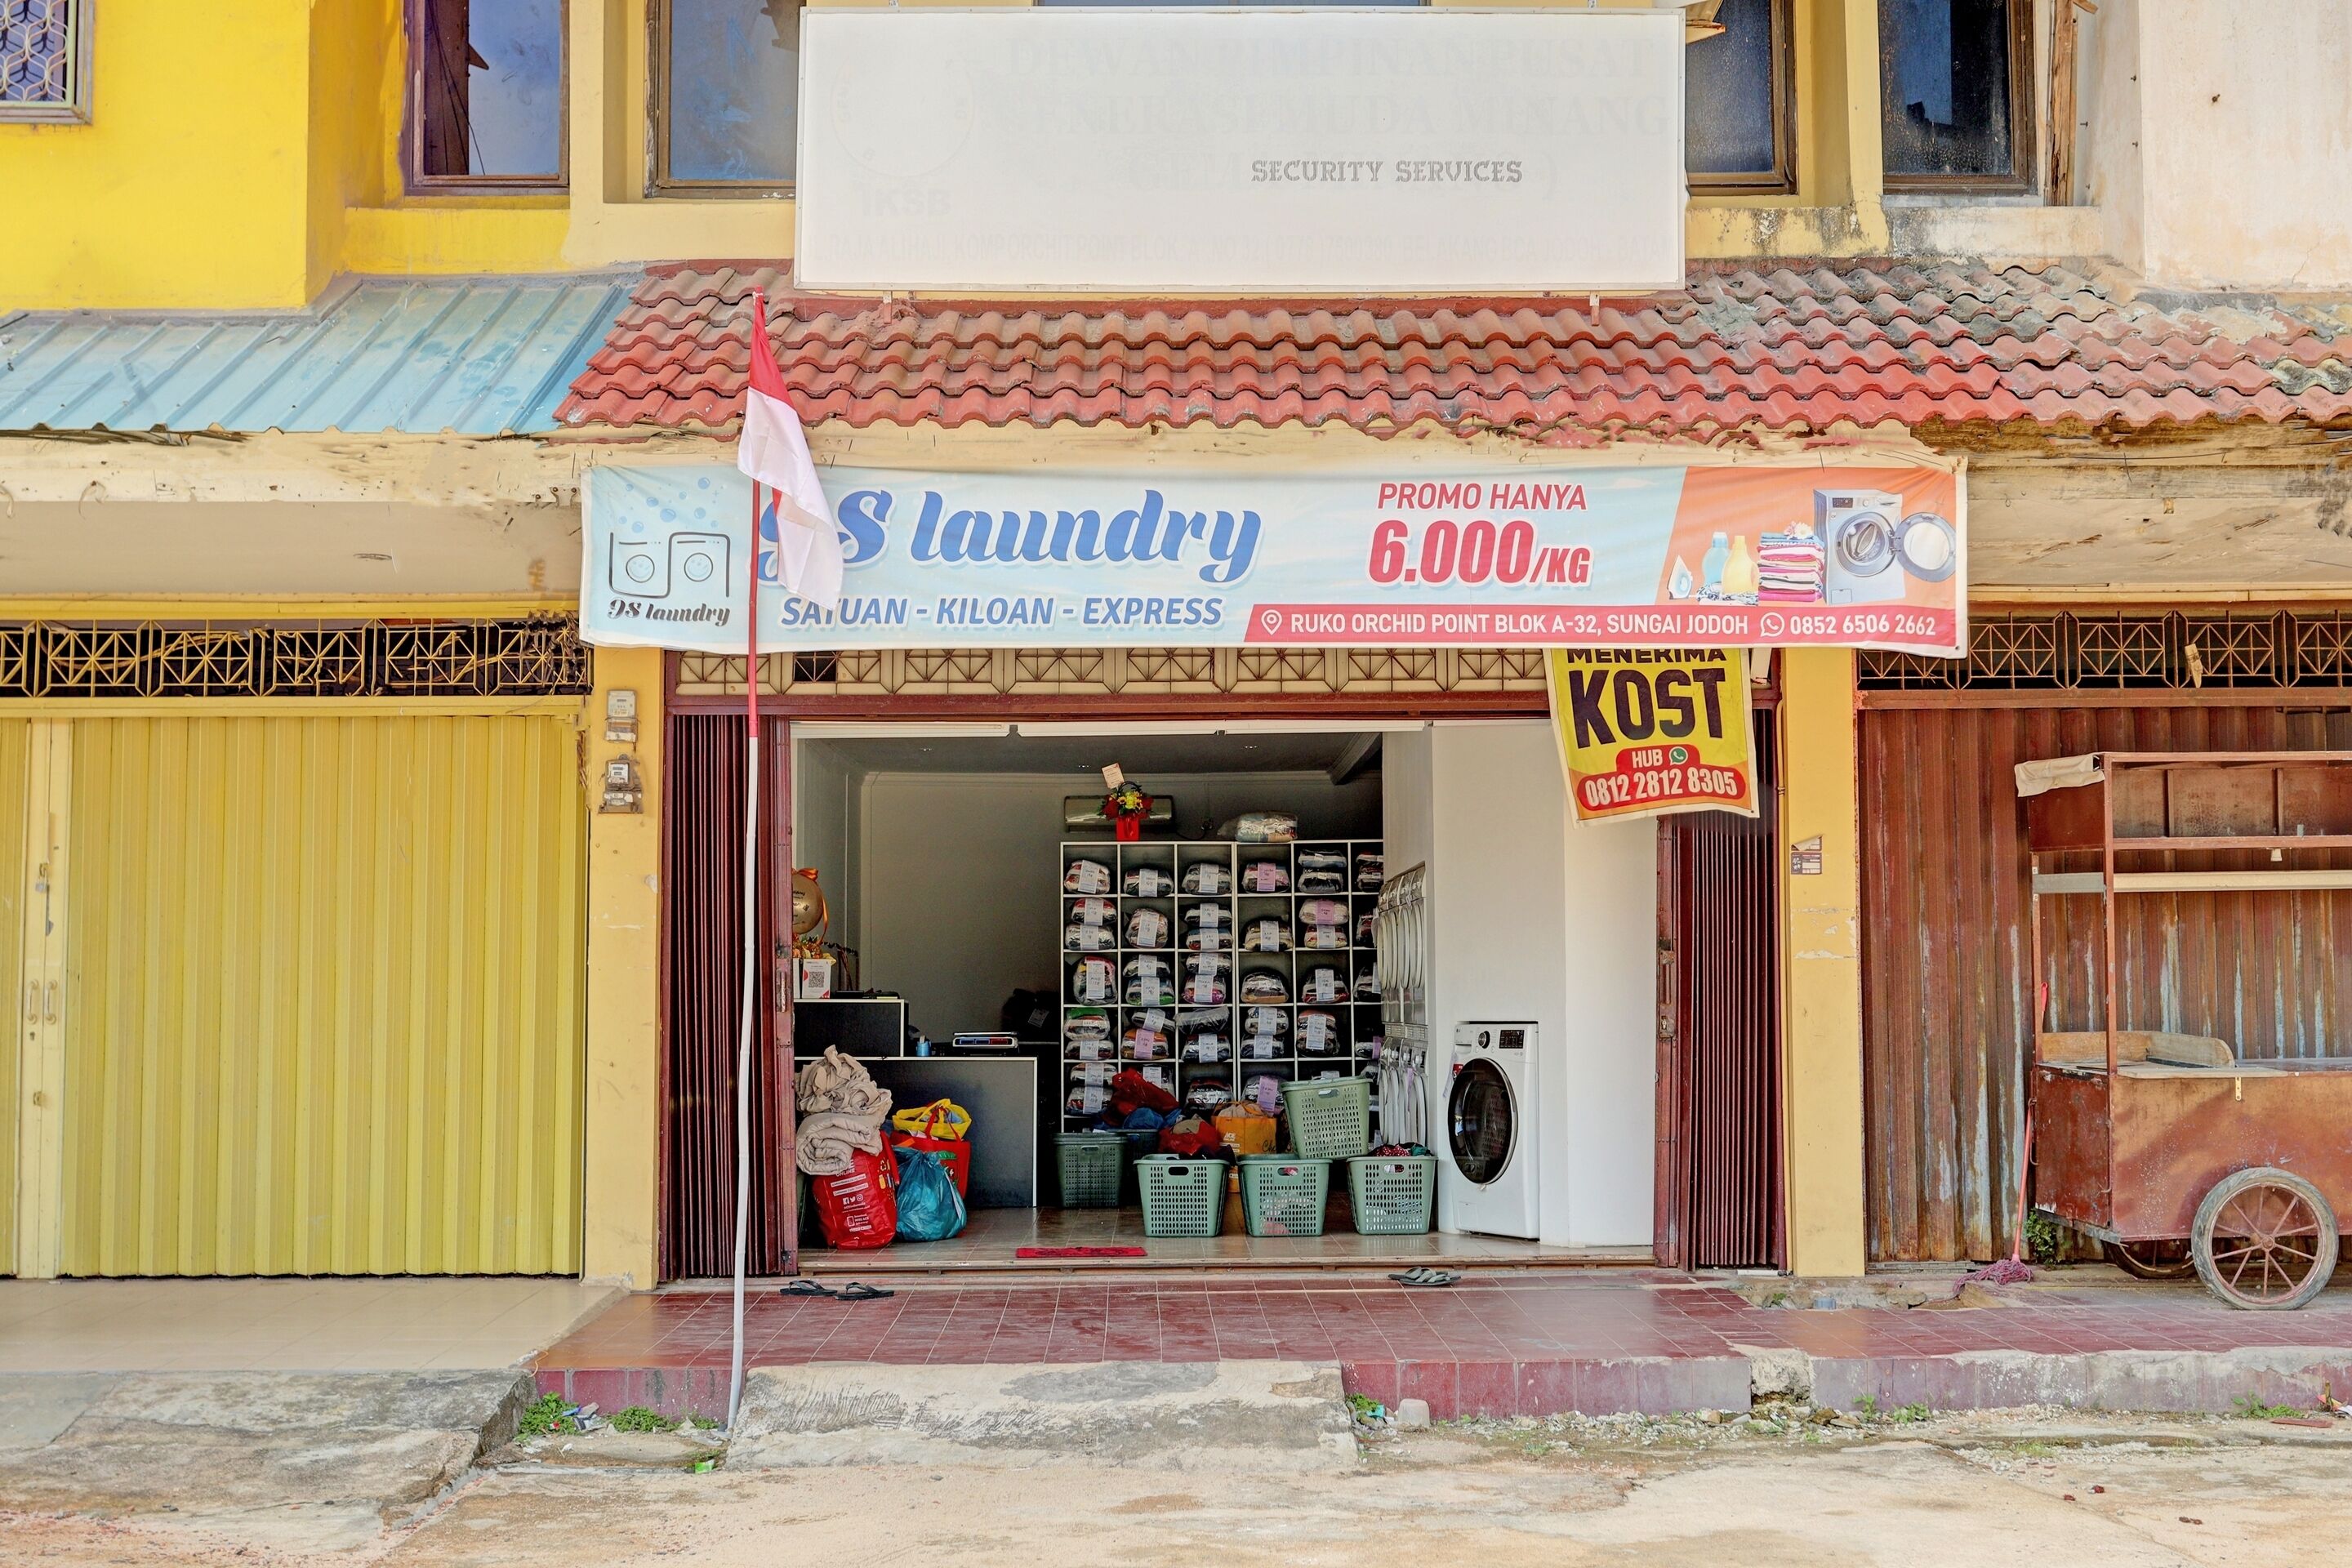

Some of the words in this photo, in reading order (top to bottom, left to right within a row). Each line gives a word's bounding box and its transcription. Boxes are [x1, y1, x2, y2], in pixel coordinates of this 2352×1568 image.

[1252, 160, 1383, 183] SECURITY
[1395, 160, 1524, 184] SERVICES
[1378, 483, 1482, 510] PROMO
[1490, 483, 1586, 511] HANYA
[911, 489, 1261, 584] laundry
[1369, 519, 1590, 588] 6.000/KG
[645, 602, 731, 627] laundry
[936, 597, 1054, 626] KILOAN
[1083, 597, 1223, 626] EXPRESS
[1290, 612, 1346, 635] RUKO
[1352, 612, 1426, 635] ORCHID
[1432, 612, 1490, 635] POINT
[1495, 612, 1546, 635] BLOK
[1552, 612, 1601, 638] A-32,
[1606, 612, 1682, 635] SUNGAI
[1687, 612, 1748, 635] JODOH
[1790, 614, 1838, 636] 0852
[1842, 614, 1890, 636] 6506
[1895, 614, 1936, 637] 2662
[1569, 668, 1726, 749] KOST
[1632, 749, 1663, 768] HUB
[1585, 775, 1631, 807] 0812
[1633, 770, 1682, 800] 2812
[1687, 768, 1737, 797] 8305
